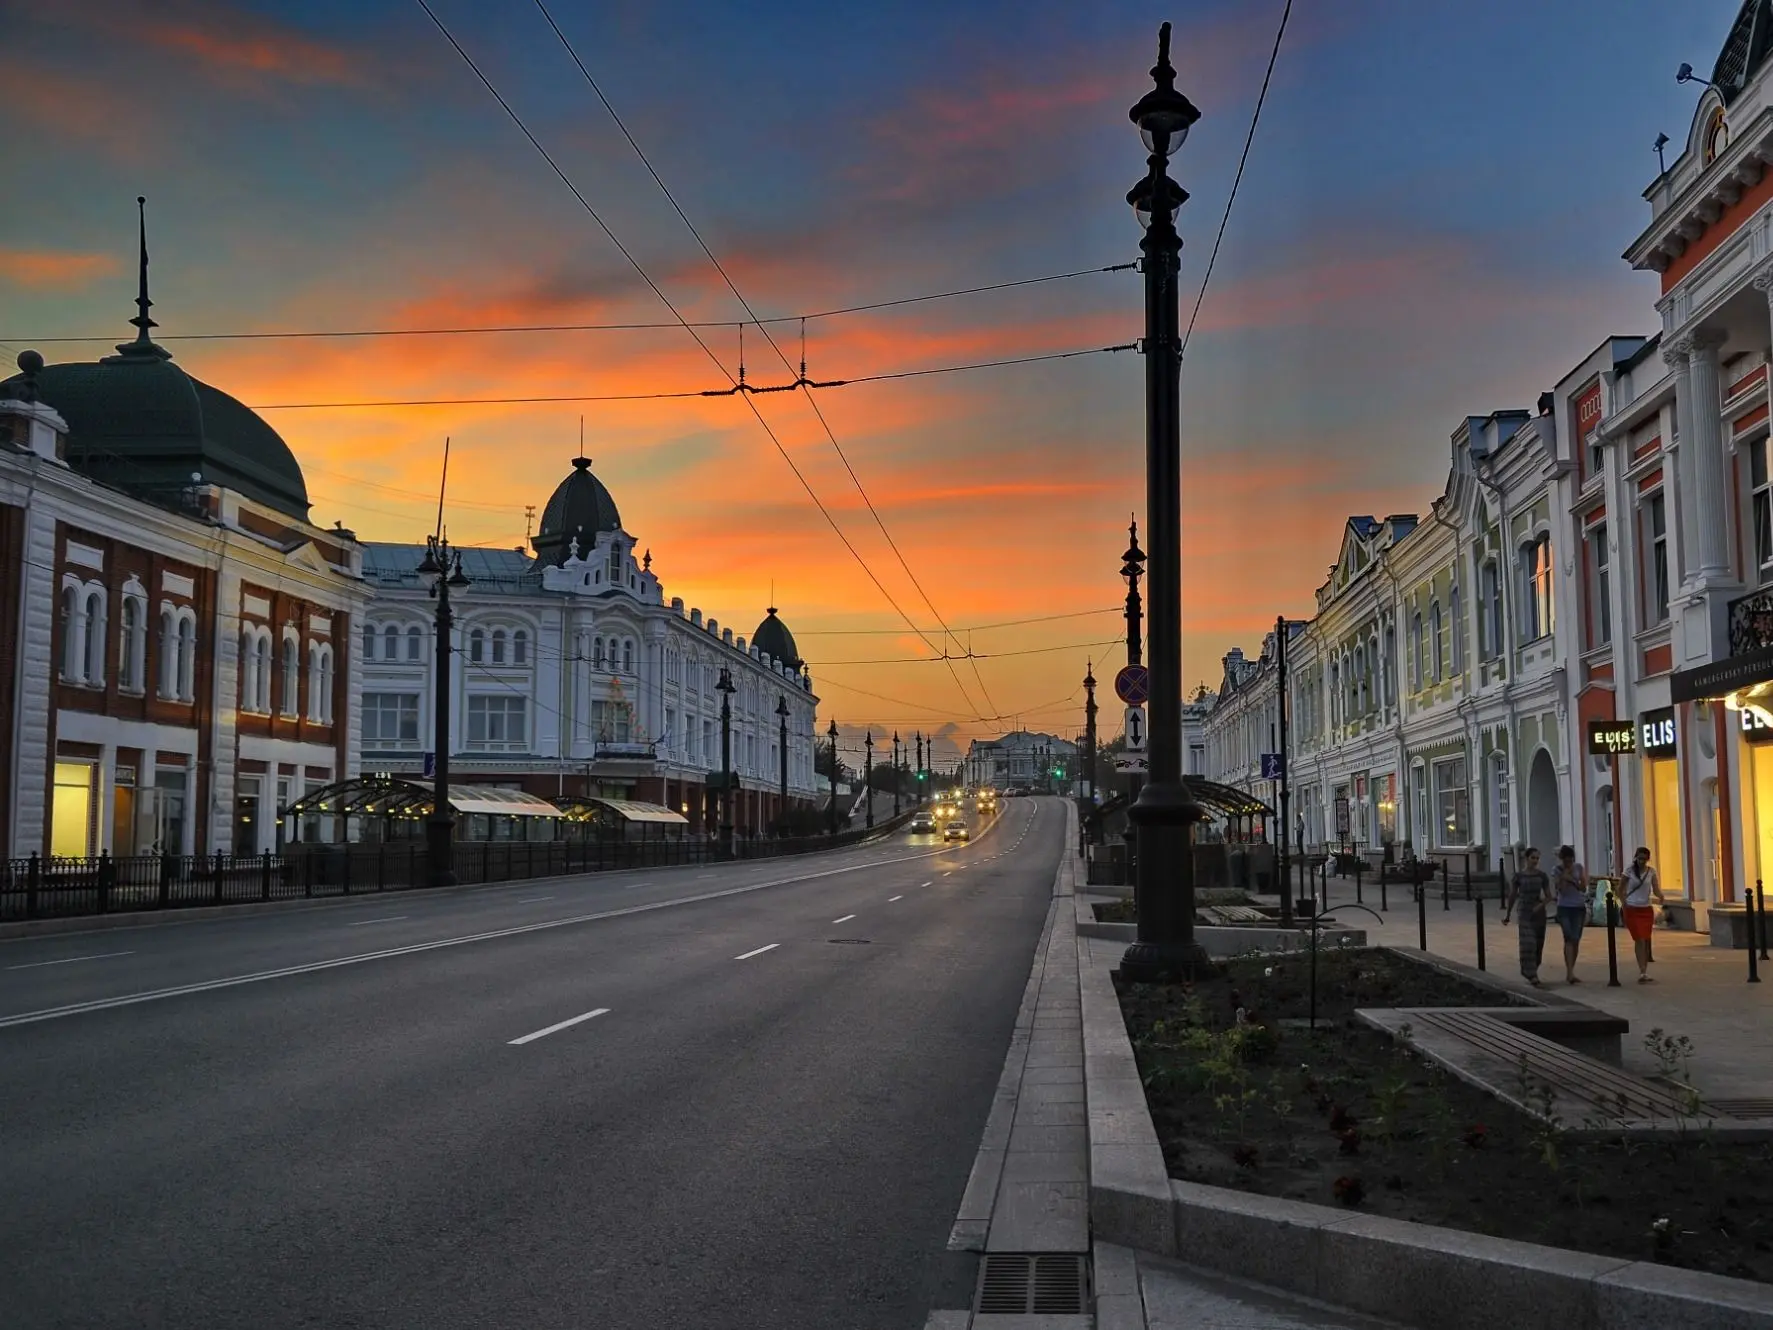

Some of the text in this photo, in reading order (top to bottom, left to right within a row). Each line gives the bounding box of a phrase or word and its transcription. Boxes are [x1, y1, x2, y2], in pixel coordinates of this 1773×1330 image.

[1741, 707, 1765, 730] EL
[1594, 732, 1630, 743] ELIS
[1642, 719, 1674, 748] ELIS
